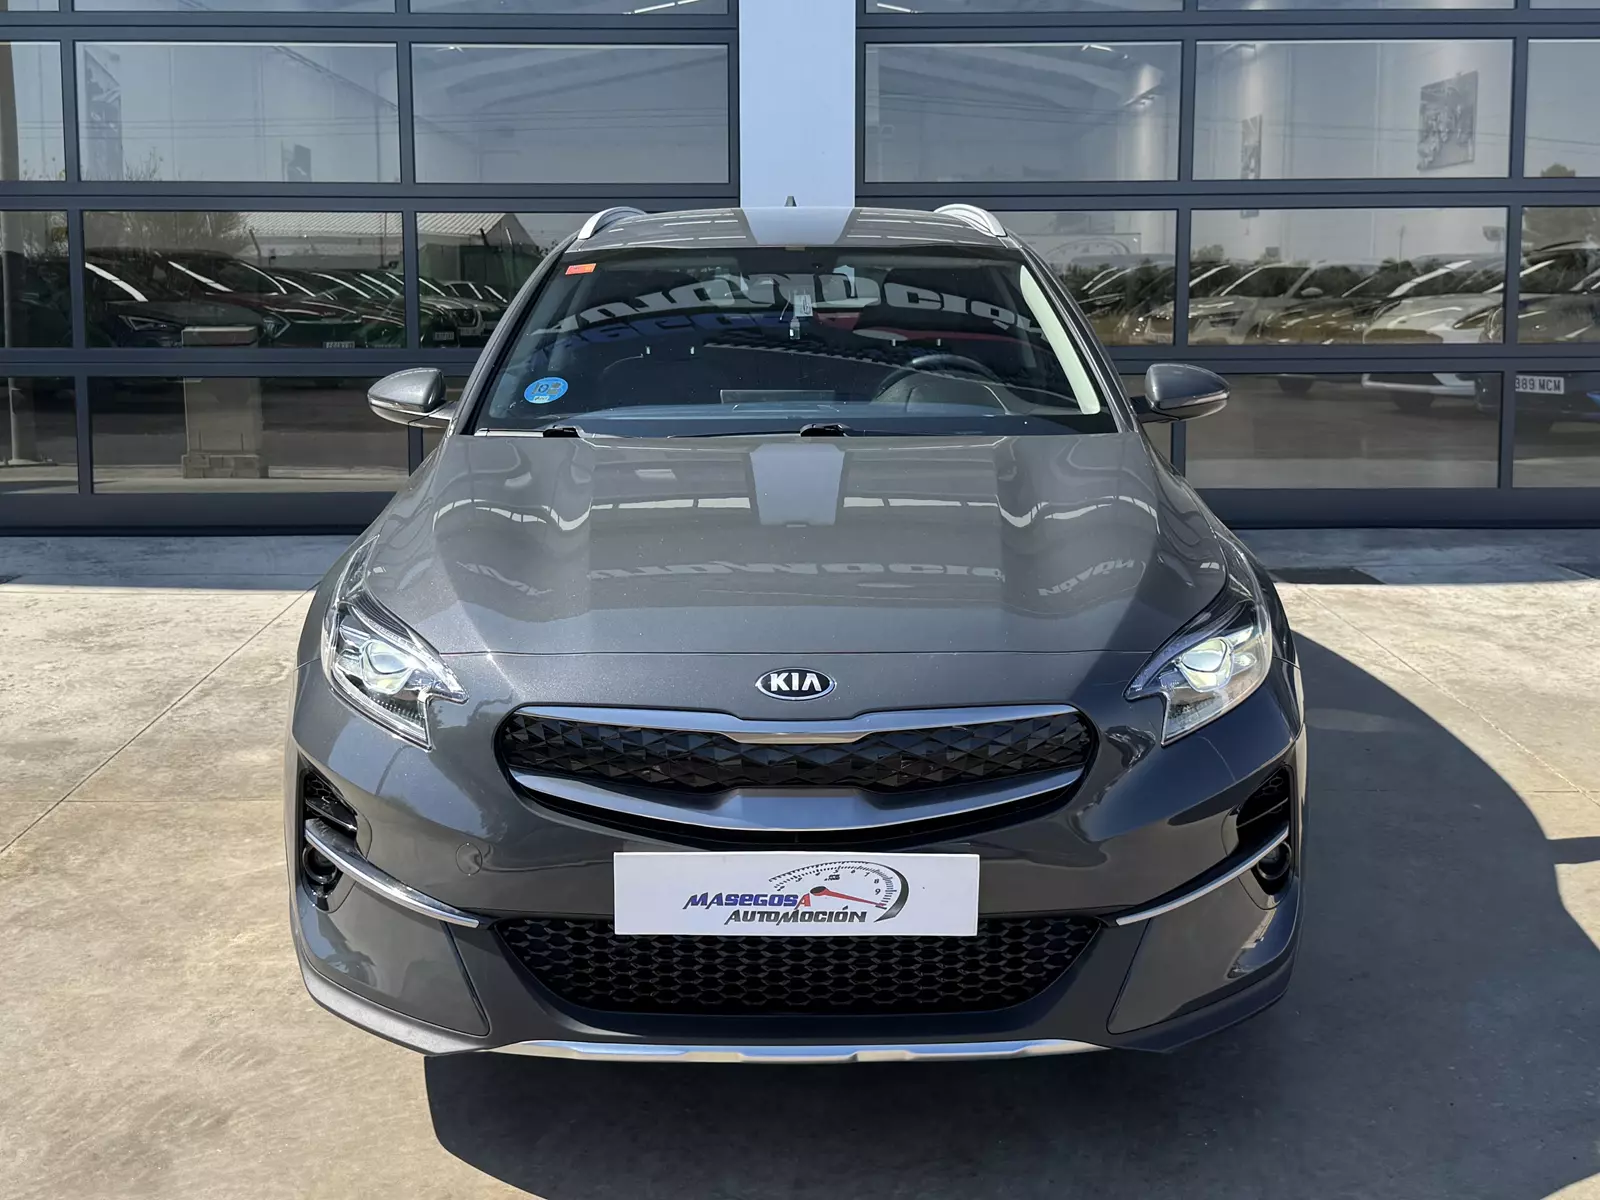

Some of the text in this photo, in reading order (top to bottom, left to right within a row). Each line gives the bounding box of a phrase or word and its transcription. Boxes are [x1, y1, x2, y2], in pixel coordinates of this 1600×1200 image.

[1538, 378, 1561, 392] MCM
[769, 672, 822, 691] KIA
[683, 892, 811, 910] MASEGOSA
[723, 905, 868, 925] AUTOMOCIÓN
